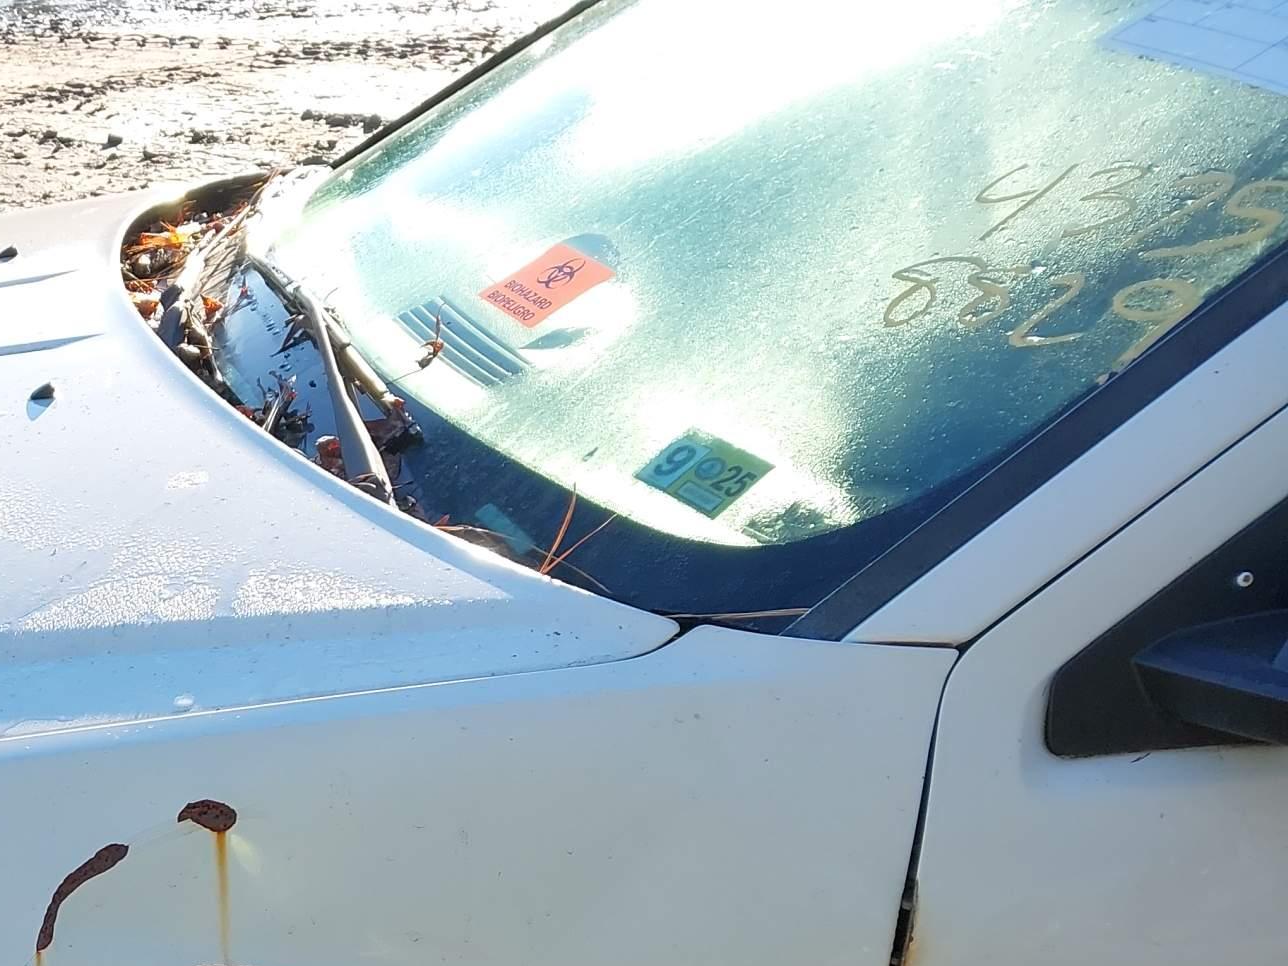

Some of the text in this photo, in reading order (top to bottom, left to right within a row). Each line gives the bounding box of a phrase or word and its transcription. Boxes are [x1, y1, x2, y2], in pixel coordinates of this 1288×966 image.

[975, 160, 1288, 258] 4375
[487, 291, 536, 321] BIOPELIGRO
[504, 280, 553, 310] BIOHAZARD
[883, 256, 1202, 384] 8829
[654, 444, 758, 498] 9 25
